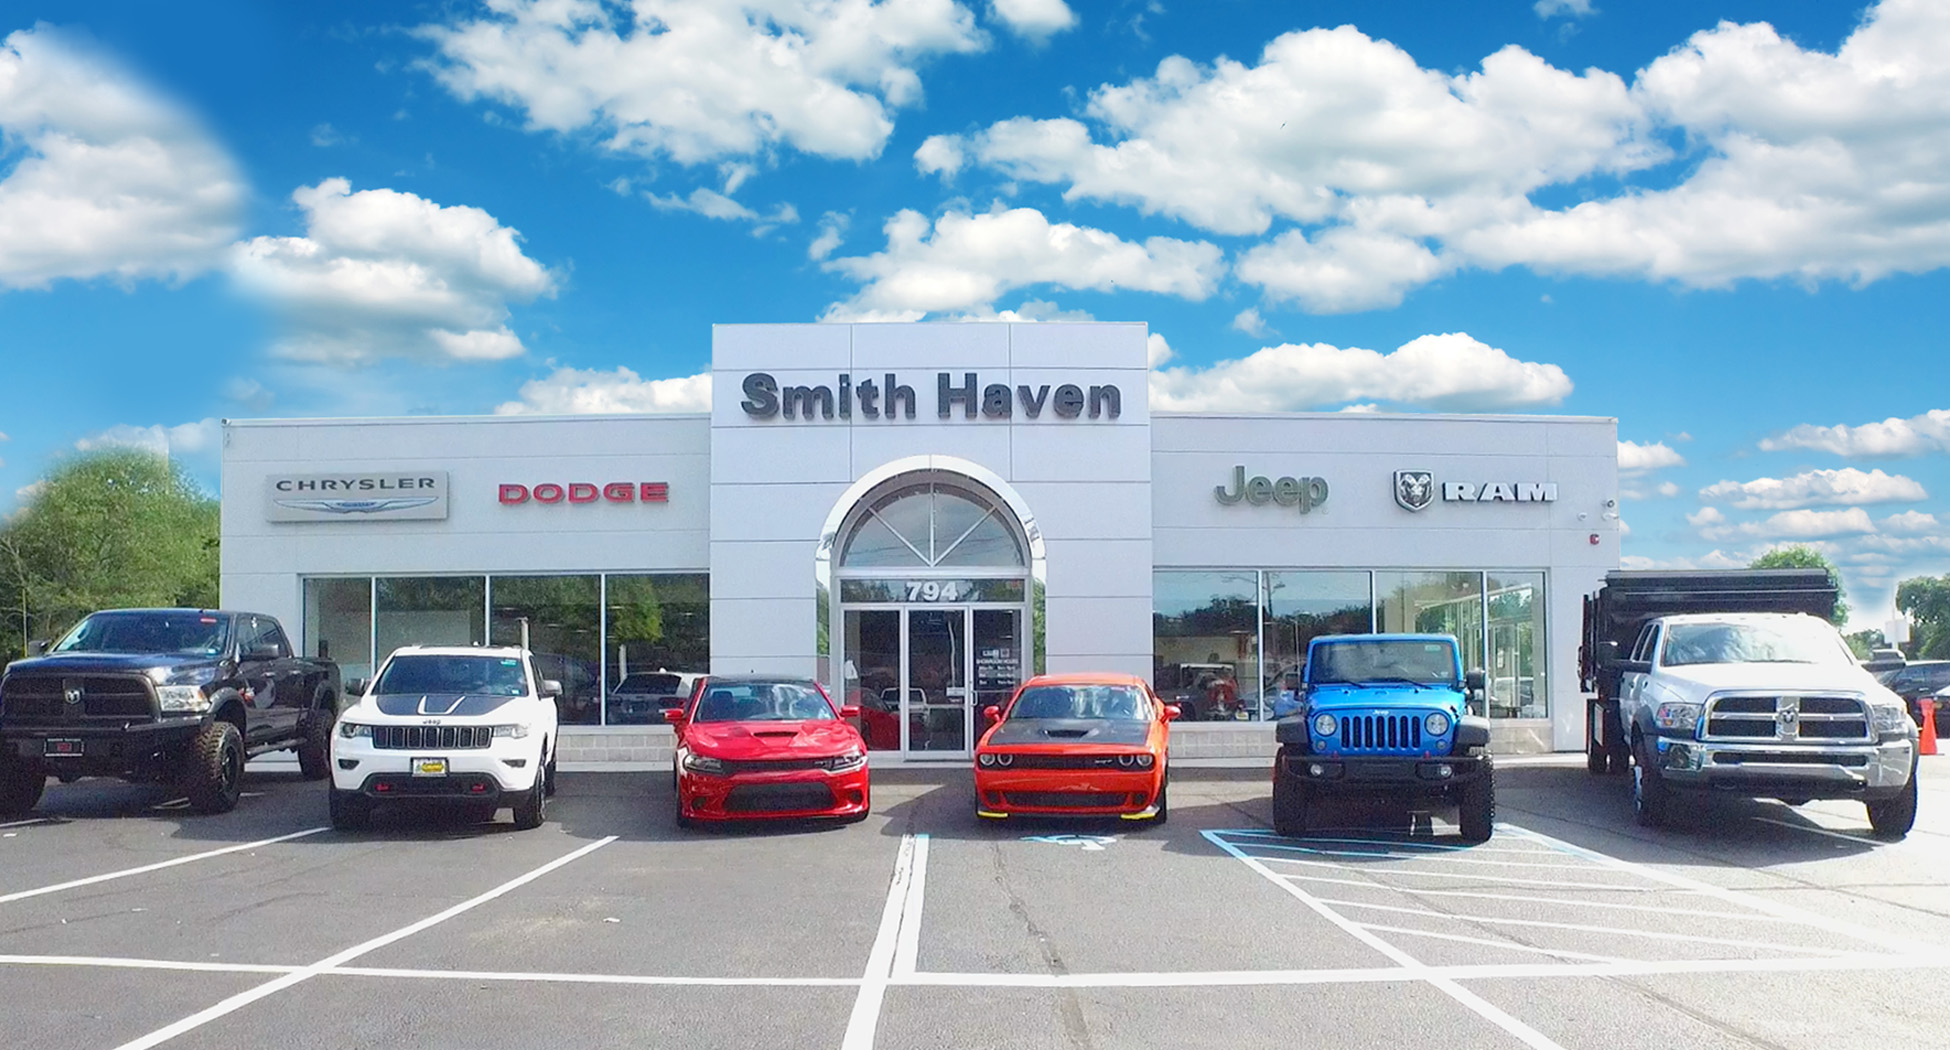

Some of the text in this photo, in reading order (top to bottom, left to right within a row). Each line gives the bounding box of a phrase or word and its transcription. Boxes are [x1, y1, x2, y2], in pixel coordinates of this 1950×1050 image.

[741, 373, 1121, 420] Smith Haven
[276, 478, 435, 491] CHRYSLER
[499, 482, 669, 504] DODGE
[1215, 465, 1329, 514] Jeep
[1443, 482, 1559, 502] RAM
[906, 581, 958, 601] 794
